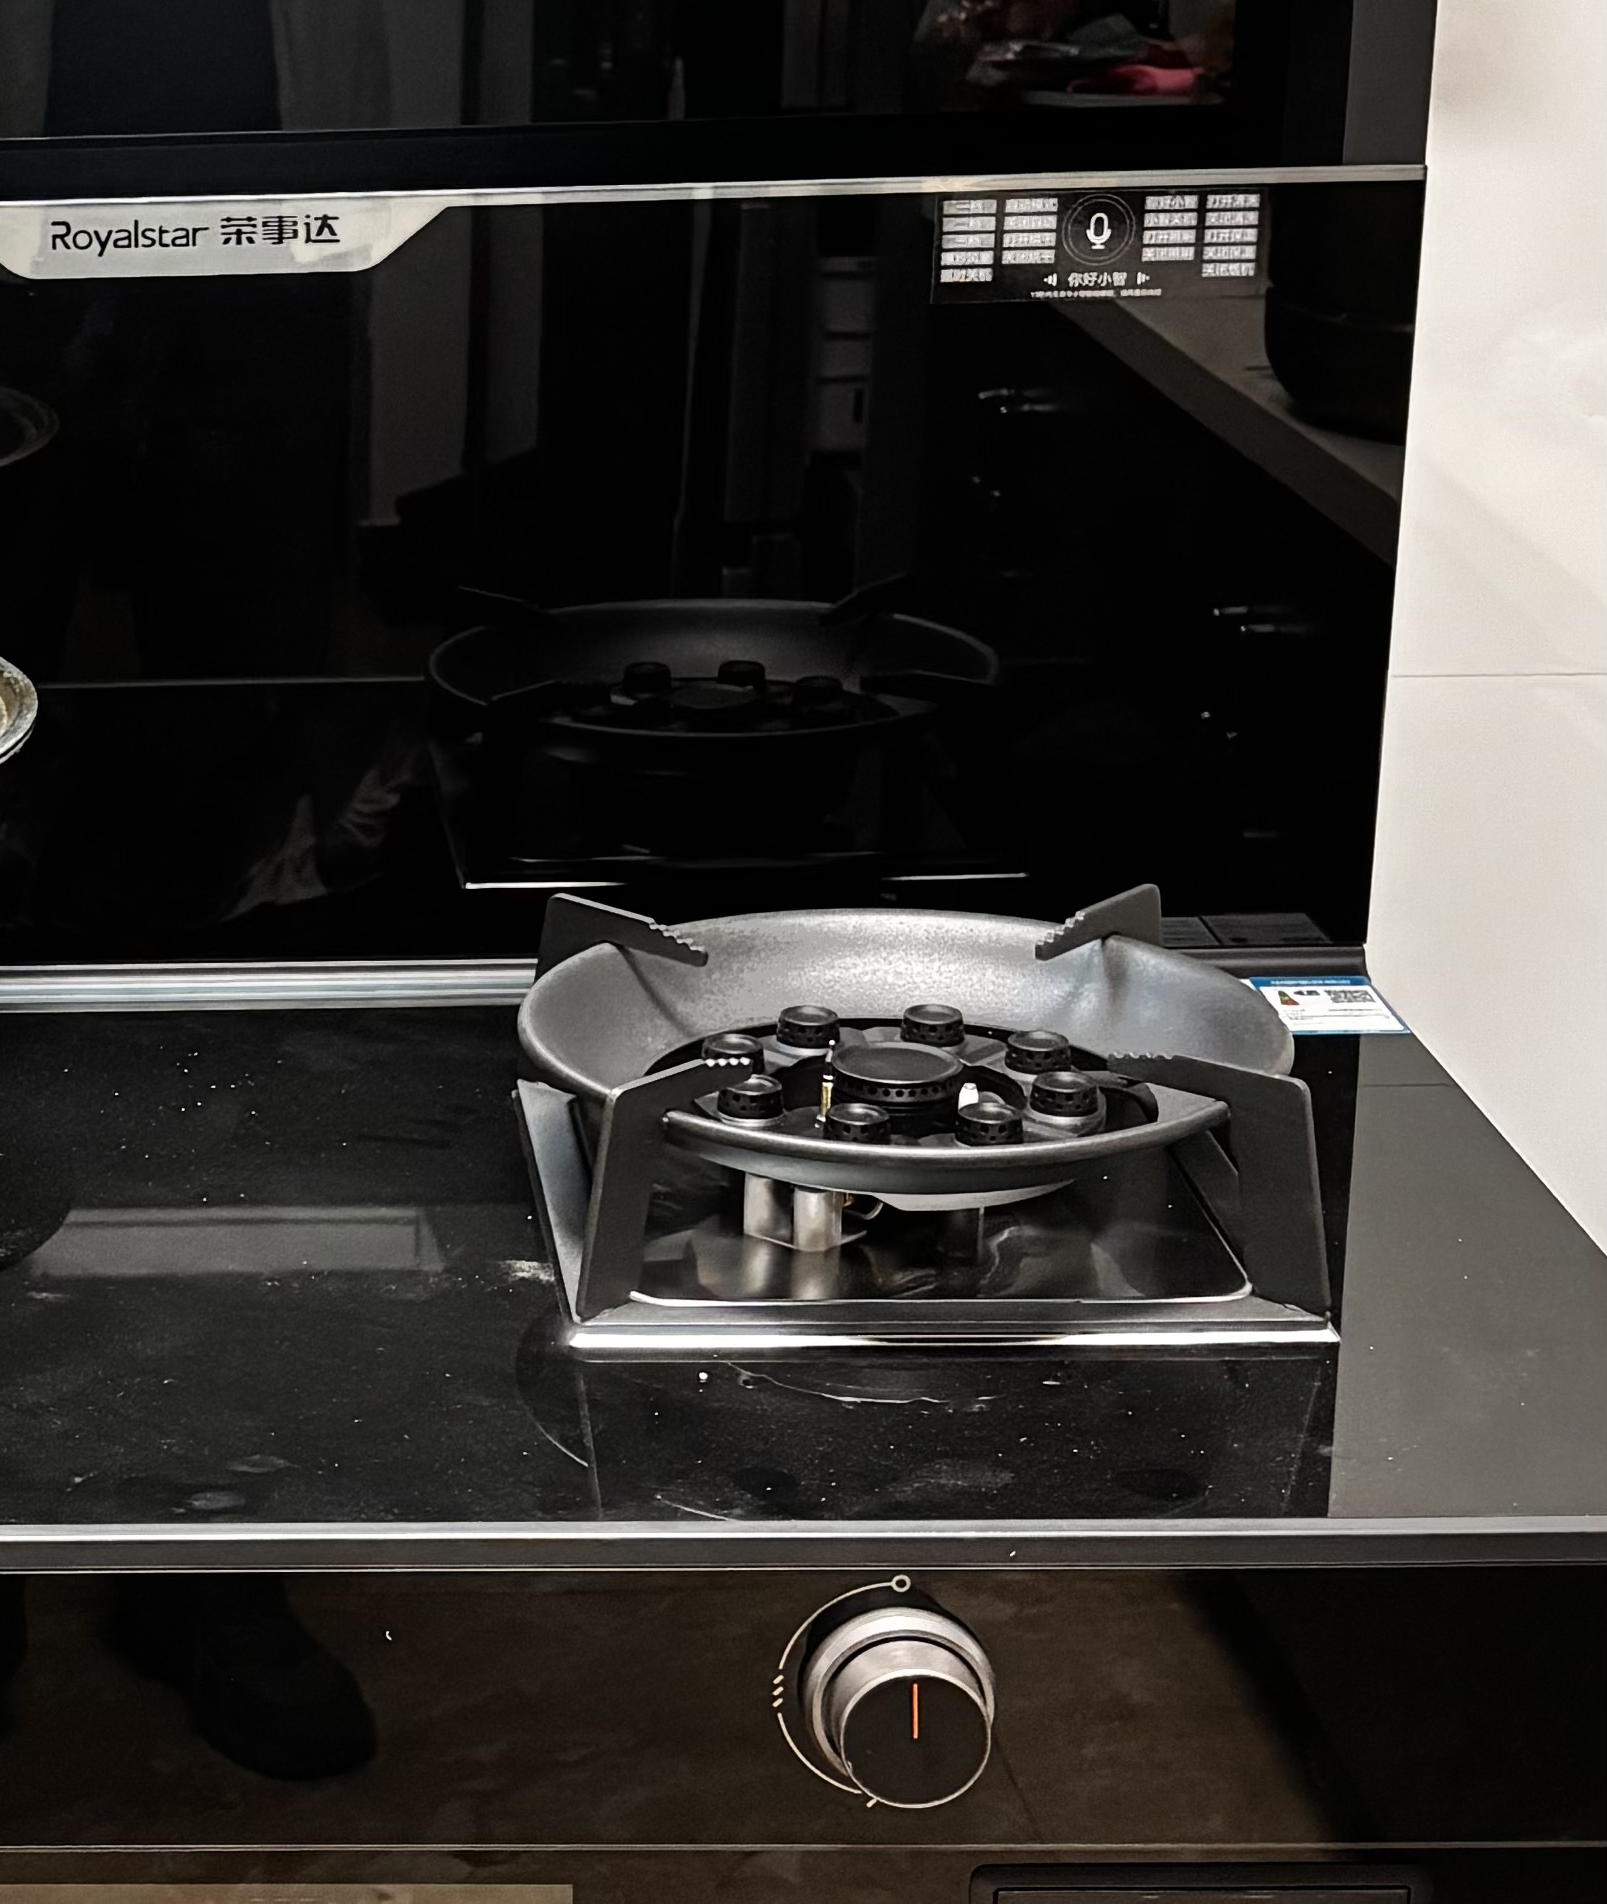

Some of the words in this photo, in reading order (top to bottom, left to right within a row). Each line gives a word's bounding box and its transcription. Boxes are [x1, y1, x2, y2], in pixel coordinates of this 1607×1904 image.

[50, 219, 210, 258] Royalstar
[219, 214, 341, 245] 荣事达
[1067, 271, 1127, 288] 你好小智
